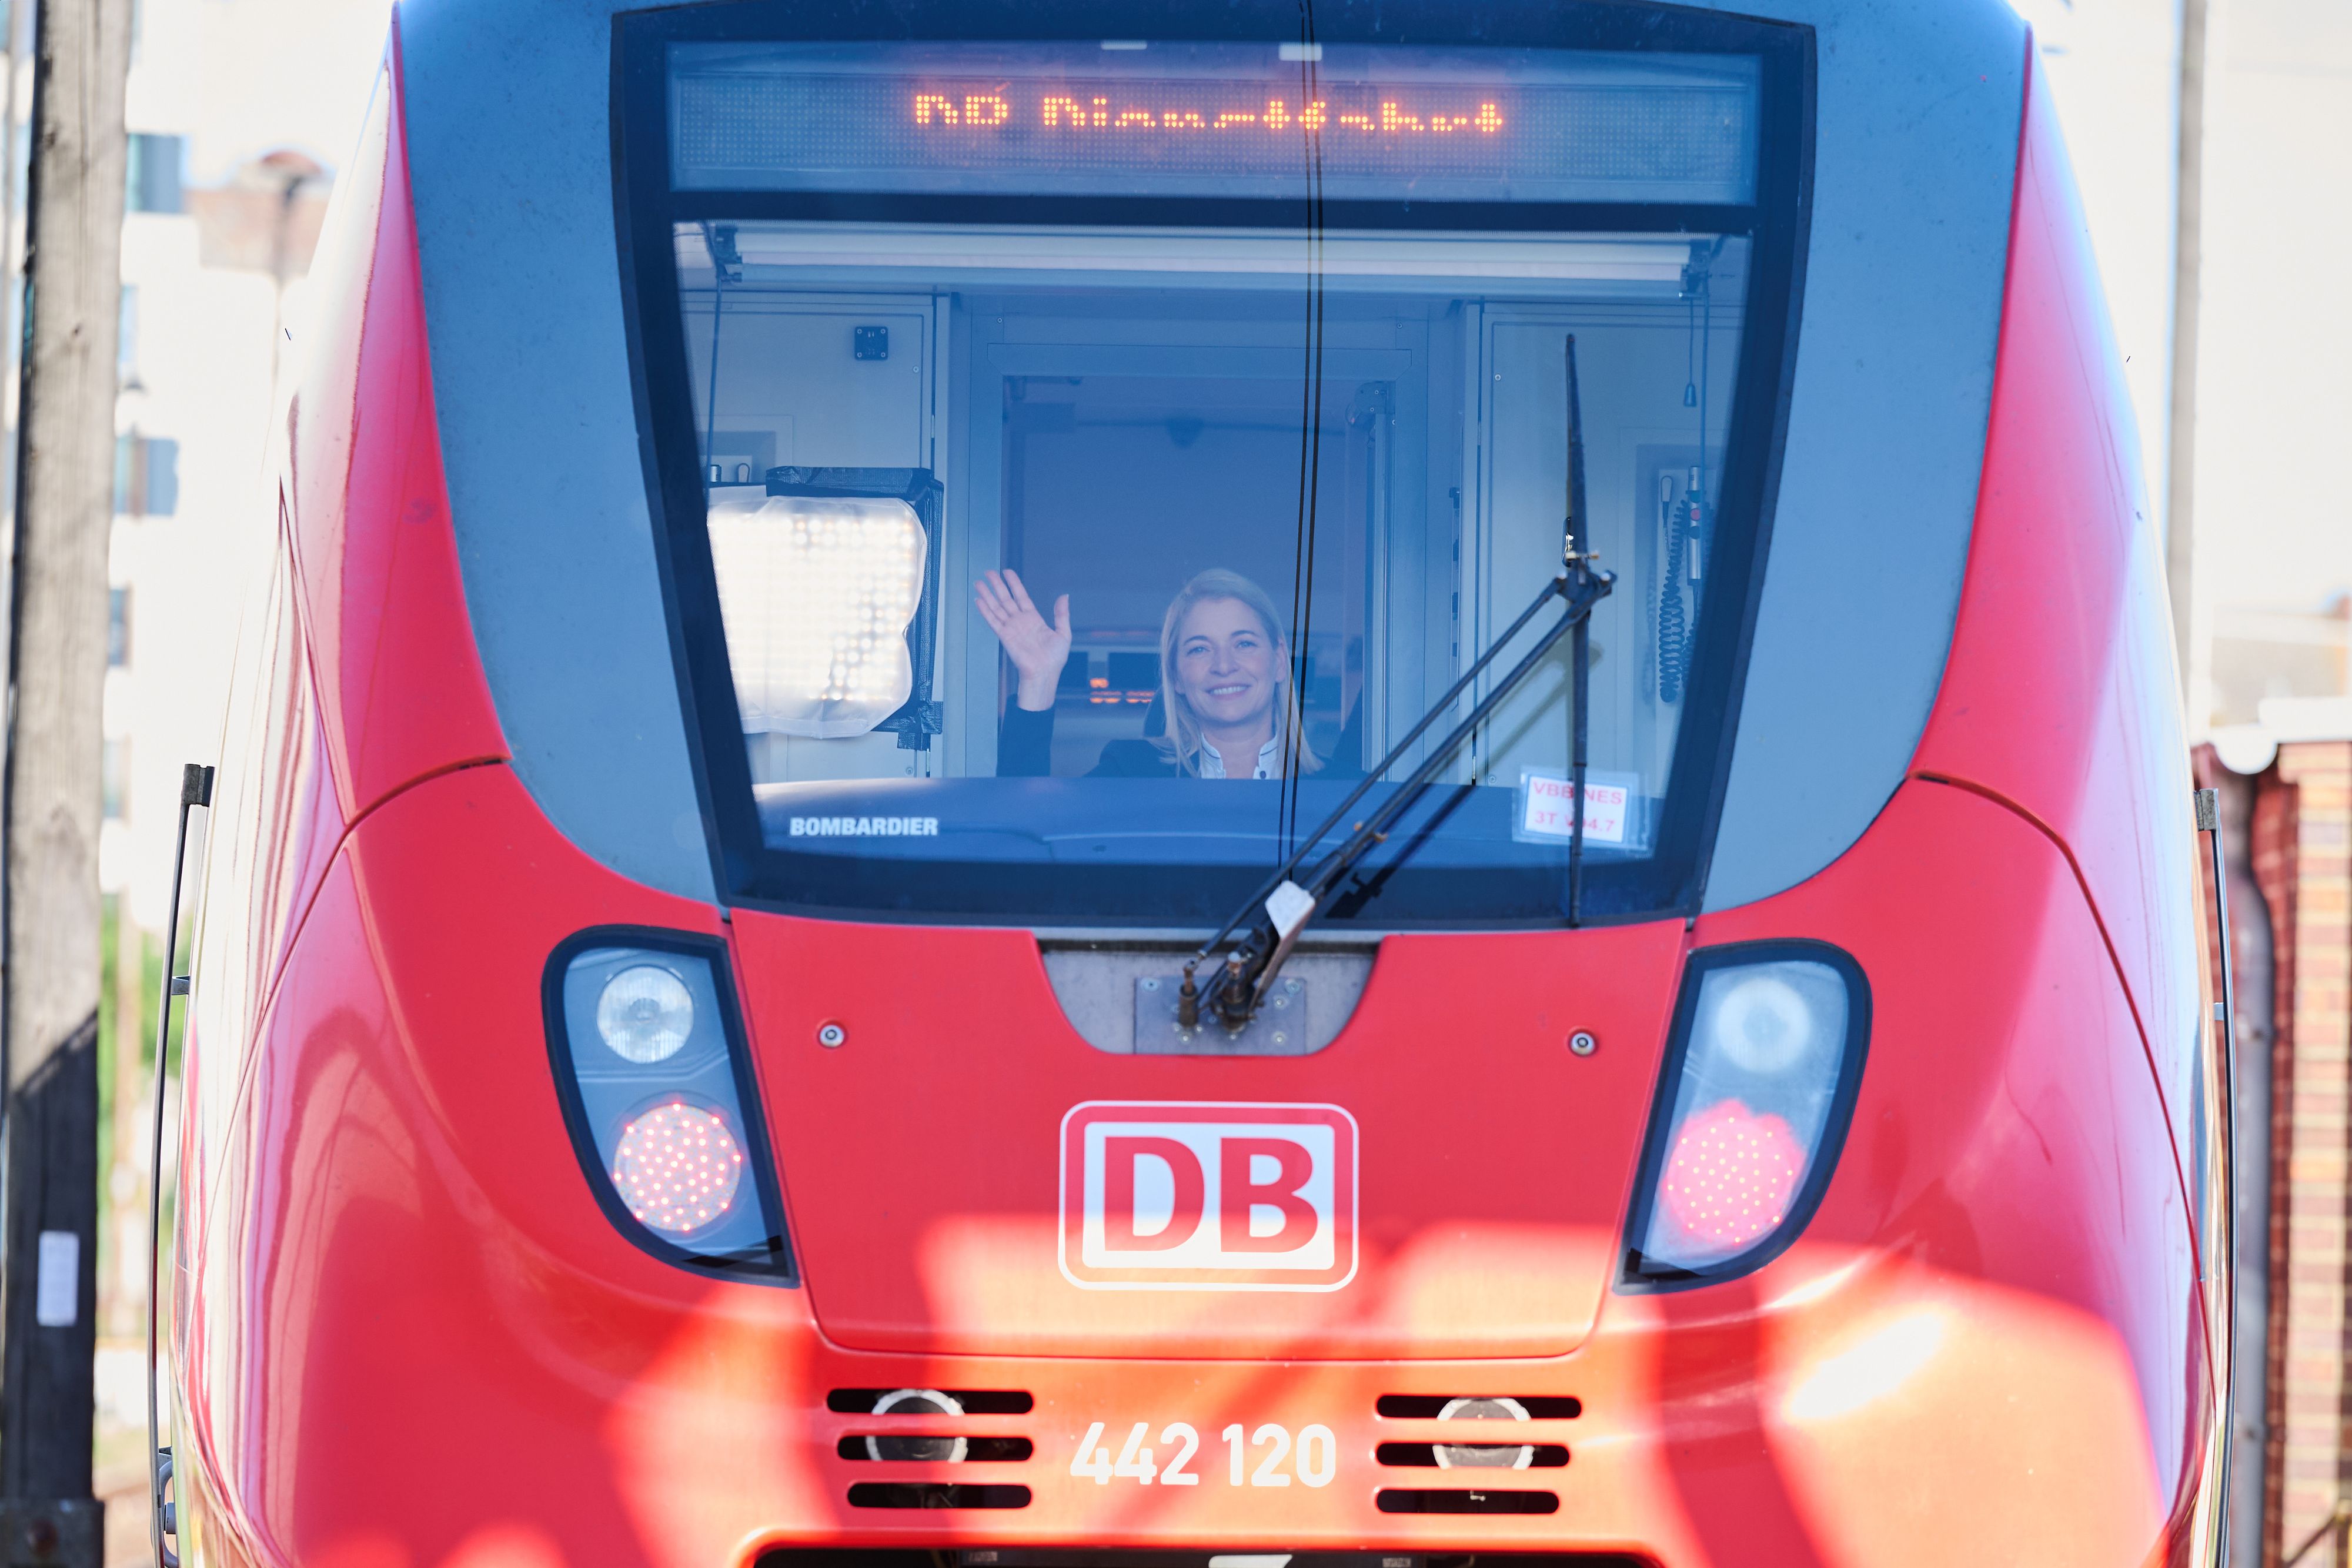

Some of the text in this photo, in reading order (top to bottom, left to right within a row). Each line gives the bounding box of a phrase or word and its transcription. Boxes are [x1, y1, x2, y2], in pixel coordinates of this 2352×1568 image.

[1533, 781, 1575, 800] VBB
[790, 817, 938, 836] BOMBARDIER
[1535, 810, 1557, 824] 3T
[1104, 1136, 1319, 1253] DB
[1070, 1422, 1337, 1487] 442 120
